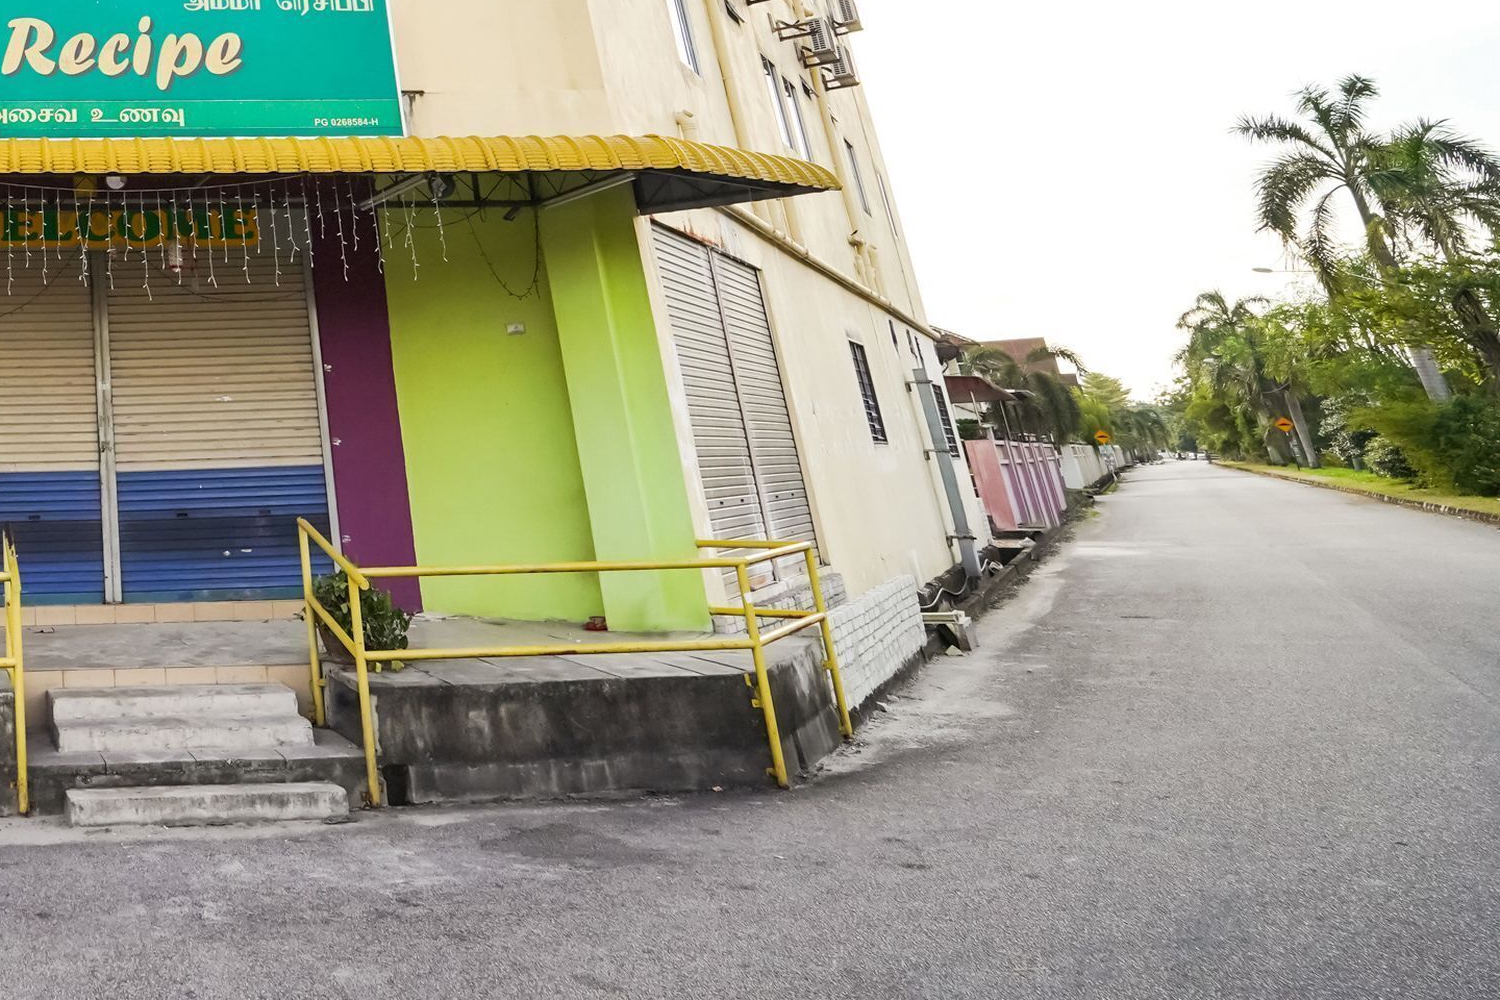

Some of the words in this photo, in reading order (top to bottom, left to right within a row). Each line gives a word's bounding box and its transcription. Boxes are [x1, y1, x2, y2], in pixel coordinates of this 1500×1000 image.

[2, 15, 242, 91] Recipe
[90, 106, 185, 128] உணவு
[314, 118, 329, 127] PG
